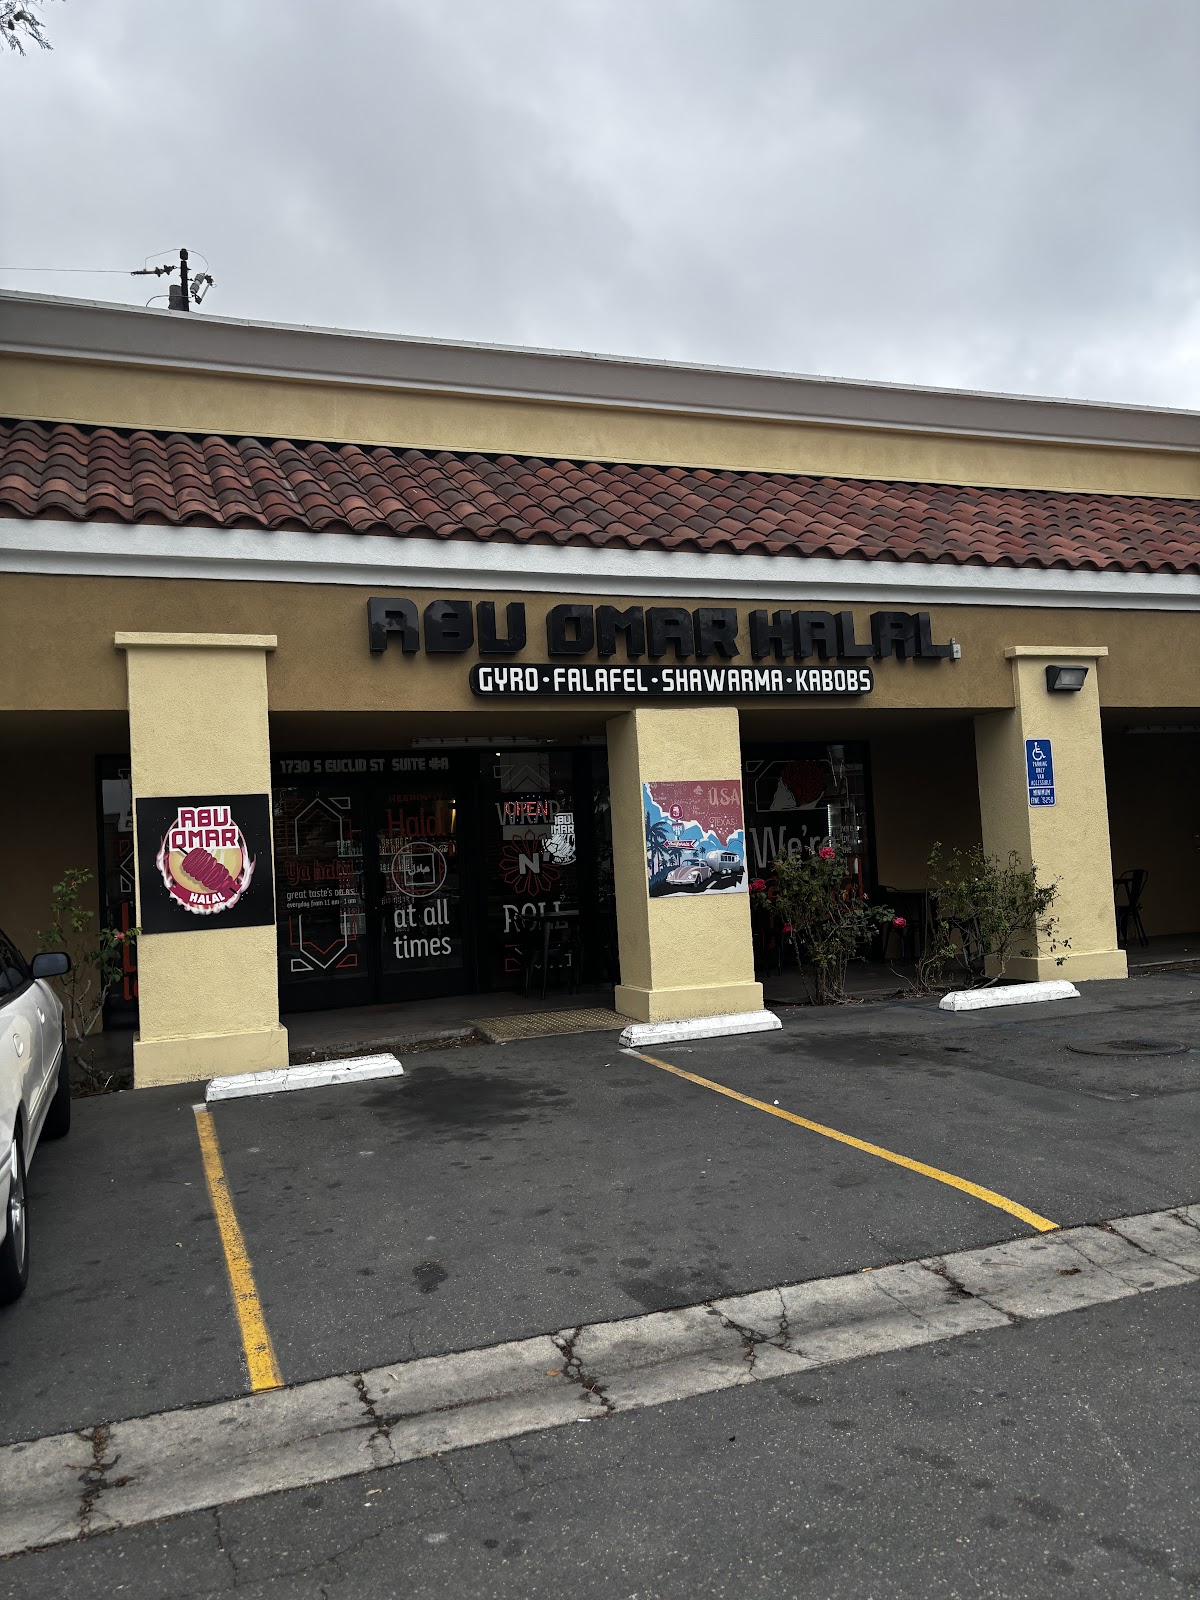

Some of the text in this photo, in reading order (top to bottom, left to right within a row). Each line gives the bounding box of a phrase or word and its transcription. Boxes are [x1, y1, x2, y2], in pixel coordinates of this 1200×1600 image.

[367, 597, 951, 662] ABU OMAR HALAL
[478, 667, 871, 692] GYRO FALAFEL SHAWARMA KABOBS
[279, 759, 311, 774] 1730
[313, 759, 322, 773] S
[324, 758, 367, 773] EUCLID
[369, 758, 385, 772] ST
[391, 757, 426, 772] SUITE
[708, 788, 741, 806] USA
[505, 800, 549, 817] OPEN
[179, 808, 229, 828] ABU
[708, 816, 736, 828] TEXAS
[171, 828, 237, 849] OMAR
[189, 891, 226, 905] HALAL
[286, 889, 307, 902] great
[309, 887, 333, 898] taste's
[286, 900, 309, 911] everyday
[393, 898, 450, 928] at all
[392, 934, 452, 960] times
